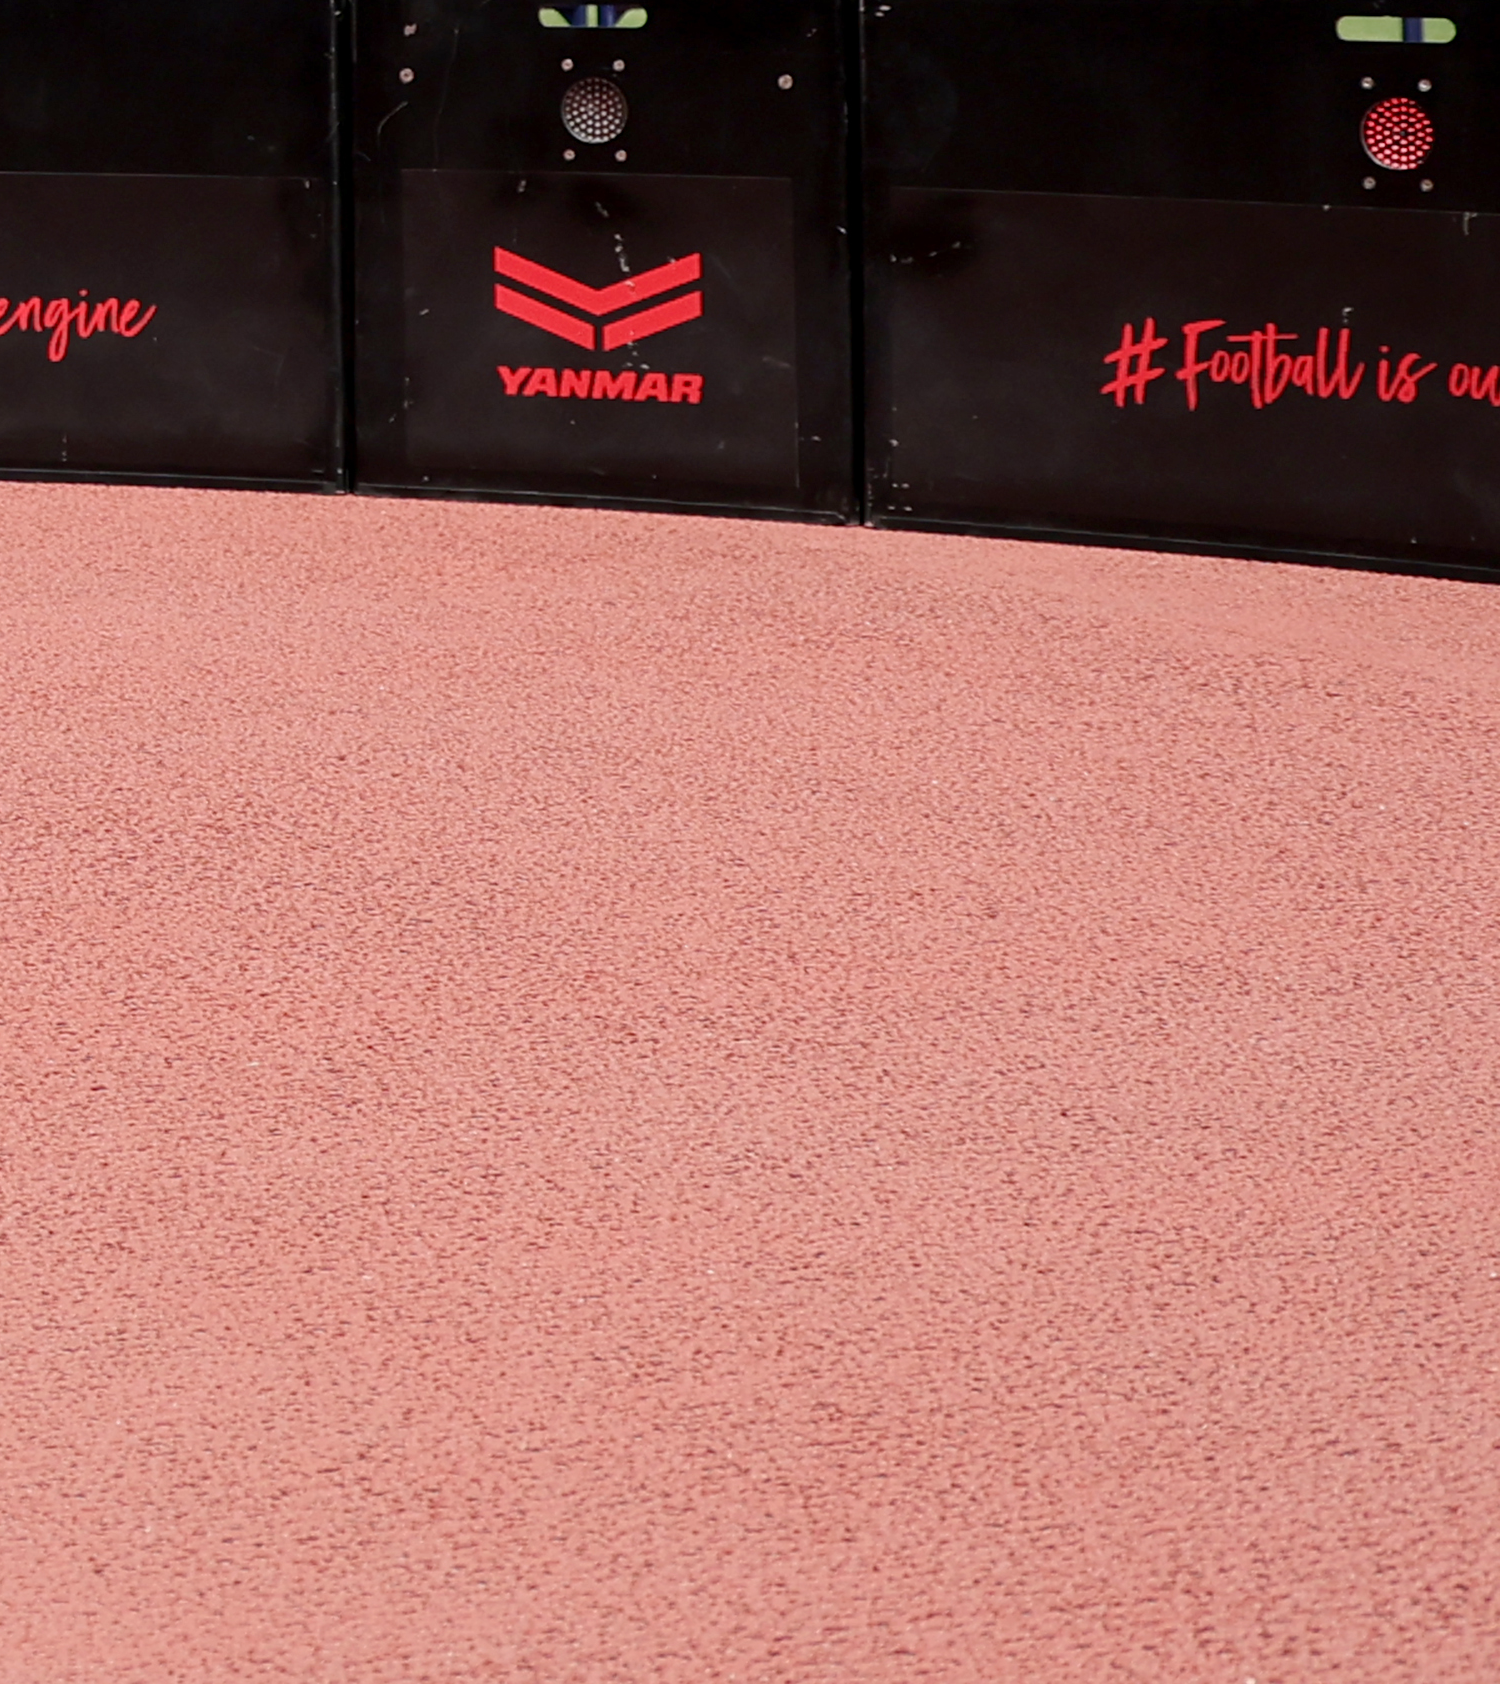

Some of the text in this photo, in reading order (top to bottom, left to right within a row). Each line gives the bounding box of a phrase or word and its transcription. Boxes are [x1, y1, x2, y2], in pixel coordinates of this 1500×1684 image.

[496, 364, 704, 405] YANMAR
[1100, 317, 1500, 412] #Football is ou
